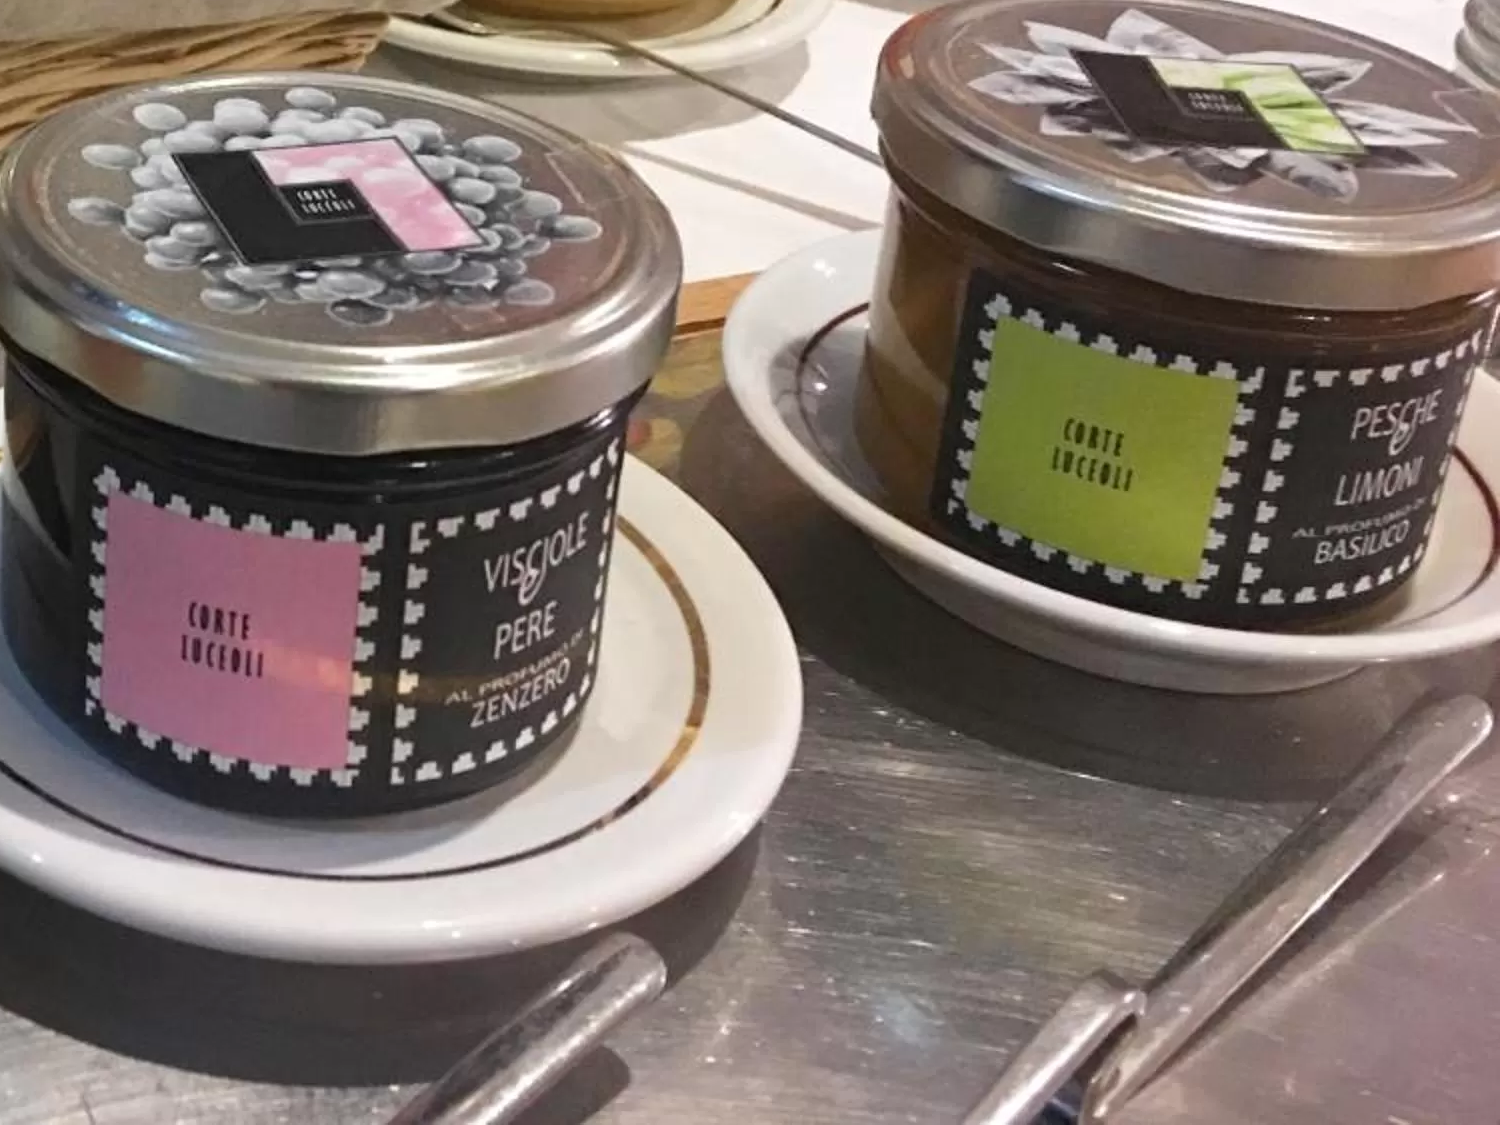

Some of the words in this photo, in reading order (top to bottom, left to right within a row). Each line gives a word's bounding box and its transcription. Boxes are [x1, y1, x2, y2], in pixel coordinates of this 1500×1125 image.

[1351, 388, 1443, 440] PESCHE
[1064, 418, 1124, 457] CORTE
[1052, 446, 1133, 491] LUCEOLI
[1334, 456, 1425, 506] LIMONI
[1314, 519, 1411, 565] BASILICO
[189, 601, 250, 641] CORTE
[493, 600, 559, 660] PERE
[181, 634, 264, 679] LUCEOLI
[470, 656, 572, 729] ZENZERO
